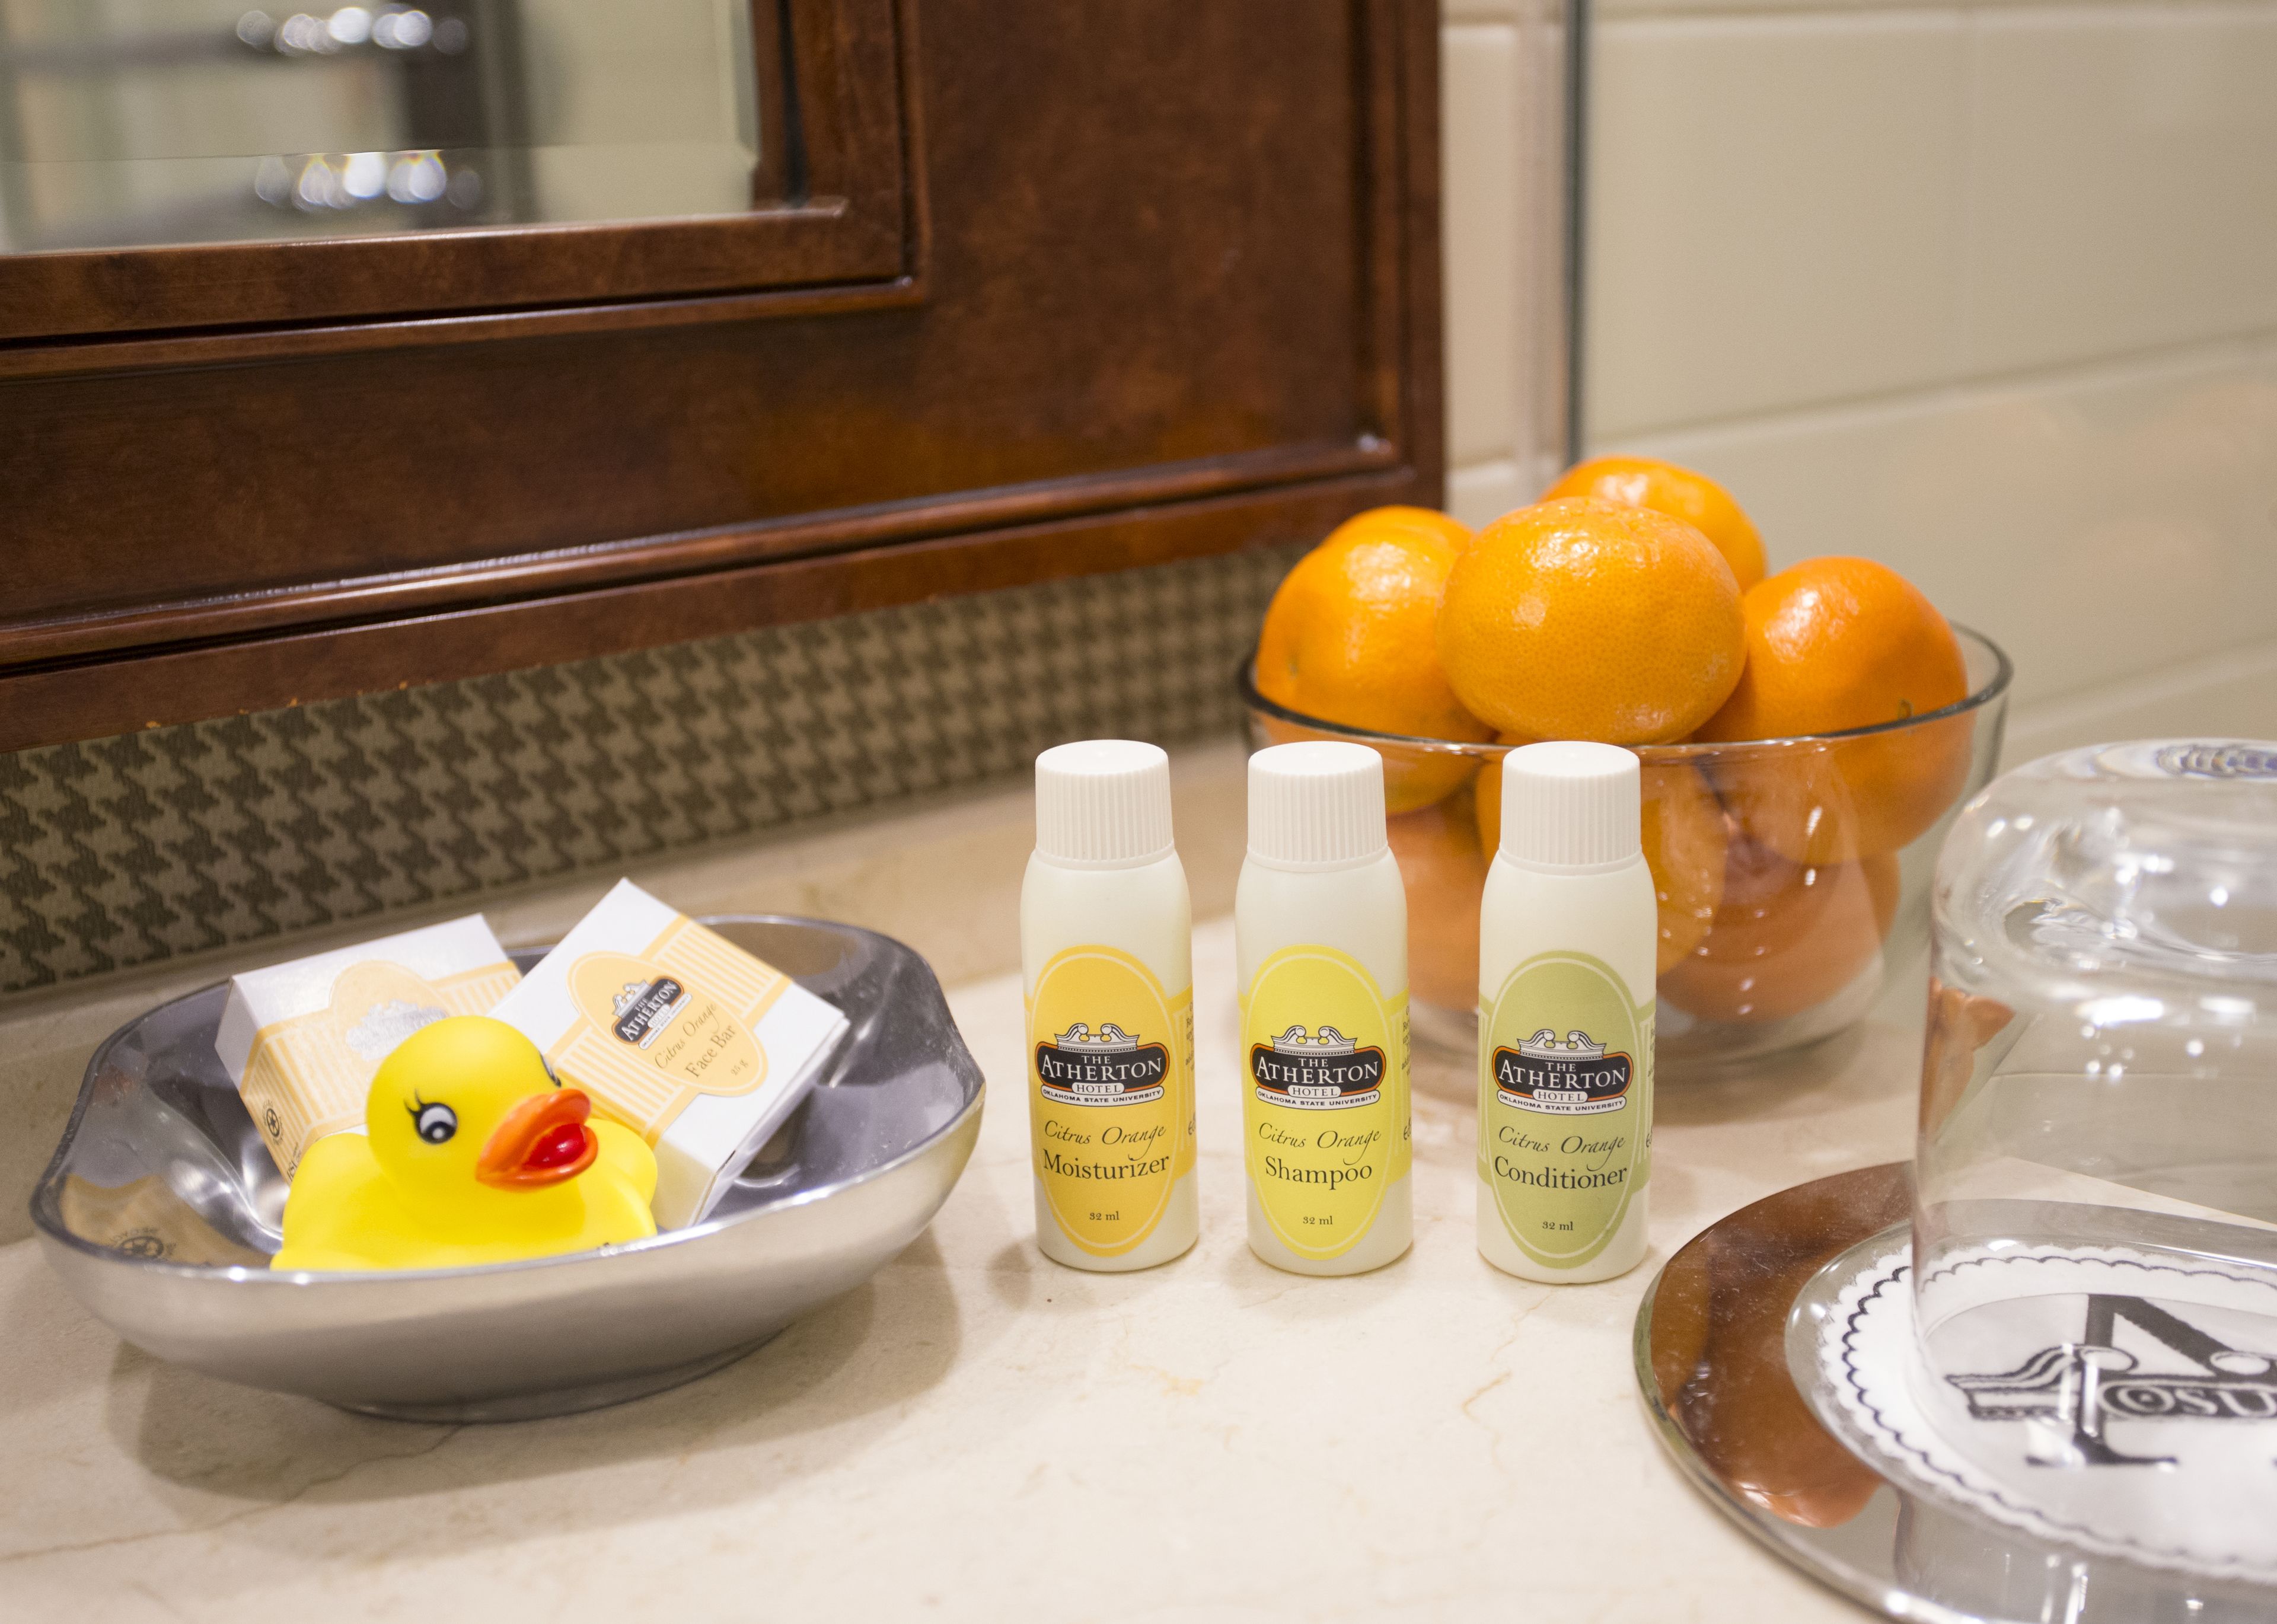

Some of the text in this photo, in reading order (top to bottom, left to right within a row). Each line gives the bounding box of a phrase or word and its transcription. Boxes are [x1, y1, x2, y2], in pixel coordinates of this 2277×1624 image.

[621, 981, 678, 1041] ATHERTON
[634, 998, 649, 1012] THE
[654, 1003, 718, 1069] Citrus Orange
[684, 1025, 738, 1078] Face Bar
[1081, 1055, 1112, 1065] THE
[1041, 1054, 1162, 1081] ATHERTON
[1255, 1056, 1379, 1084] ATHERTON
[1297, 1058, 1329, 1068] THE
[1545, 1062, 1576, 1072] THE
[1498, 1059, 1627, 1089] ATHERTON
[1042, 1089, 1081, 1102] OKLAHOMA
[1112, 1089, 1162, 1103] UNIVERSITY
[1076, 1084, 1121, 1094] HOTEL
[1258, 1090, 1297, 1105] OKLAHOMA
[1328, 1093, 1377, 1107] UNIVERSITY
[1291, 1087, 1338, 1097] HOTEL
[1537, 1091, 1584, 1102] HOTEL
[1499, 1093, 1542, 1109] OKLAHOMA
[1575, 1099, 1624, 1112] UNIVERSITY
[1044, 1120, 1092, 1146] Citrus
[1101, 1124, 1167, 1162] Orange
[1258, 1122, 1306, 1149] Citrus
[1316, 1127, 1382, 1166] Orange
[1498, 1125, 1551, 1153] Citrus
[1560, 1135, 1626, 1172] Orange
[1043, 1149, 1171, 1180] Moisturizer
[1265, 1156, 1373, 1191] Shampoo
[1494, 1156, 1628, 1190] Conditioner
[1089, 1211, 1120, 1221] 32 ml
[1302, 1215, 1334, 1226] 32 ml
[1542, 1220, 1574, 1232] 32 ml
